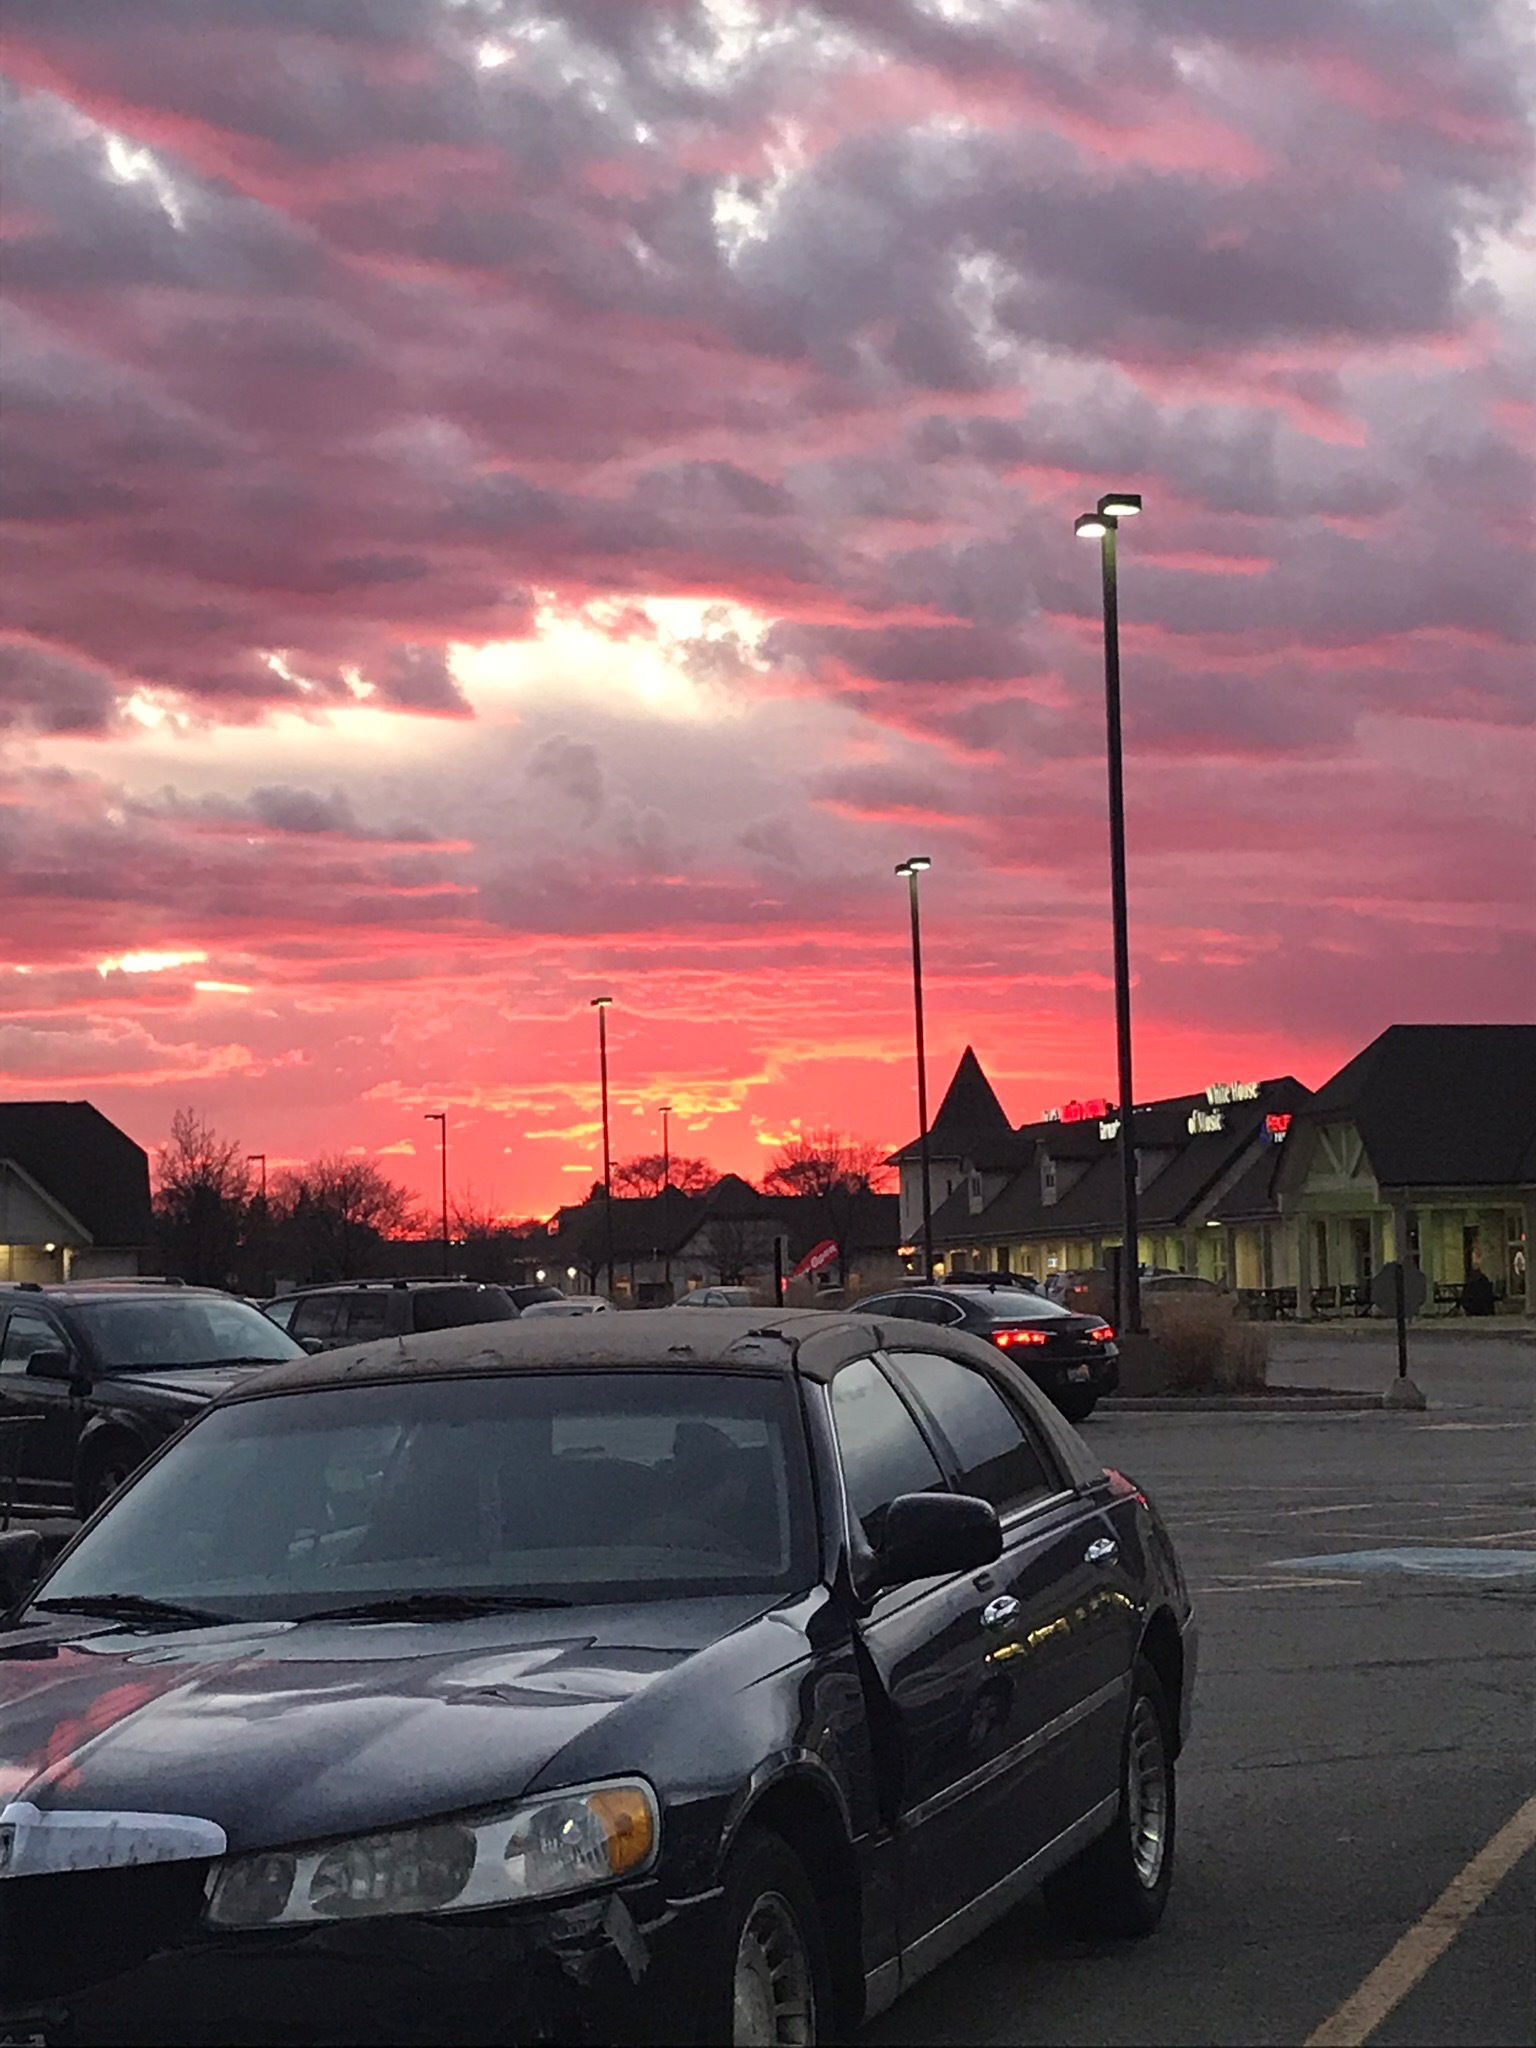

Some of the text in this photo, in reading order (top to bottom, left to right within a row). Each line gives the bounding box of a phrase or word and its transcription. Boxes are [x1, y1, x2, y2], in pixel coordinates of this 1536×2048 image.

[1205, 1082, 1259, 1105] White House
[811, 1245, 838, 1268] Open
